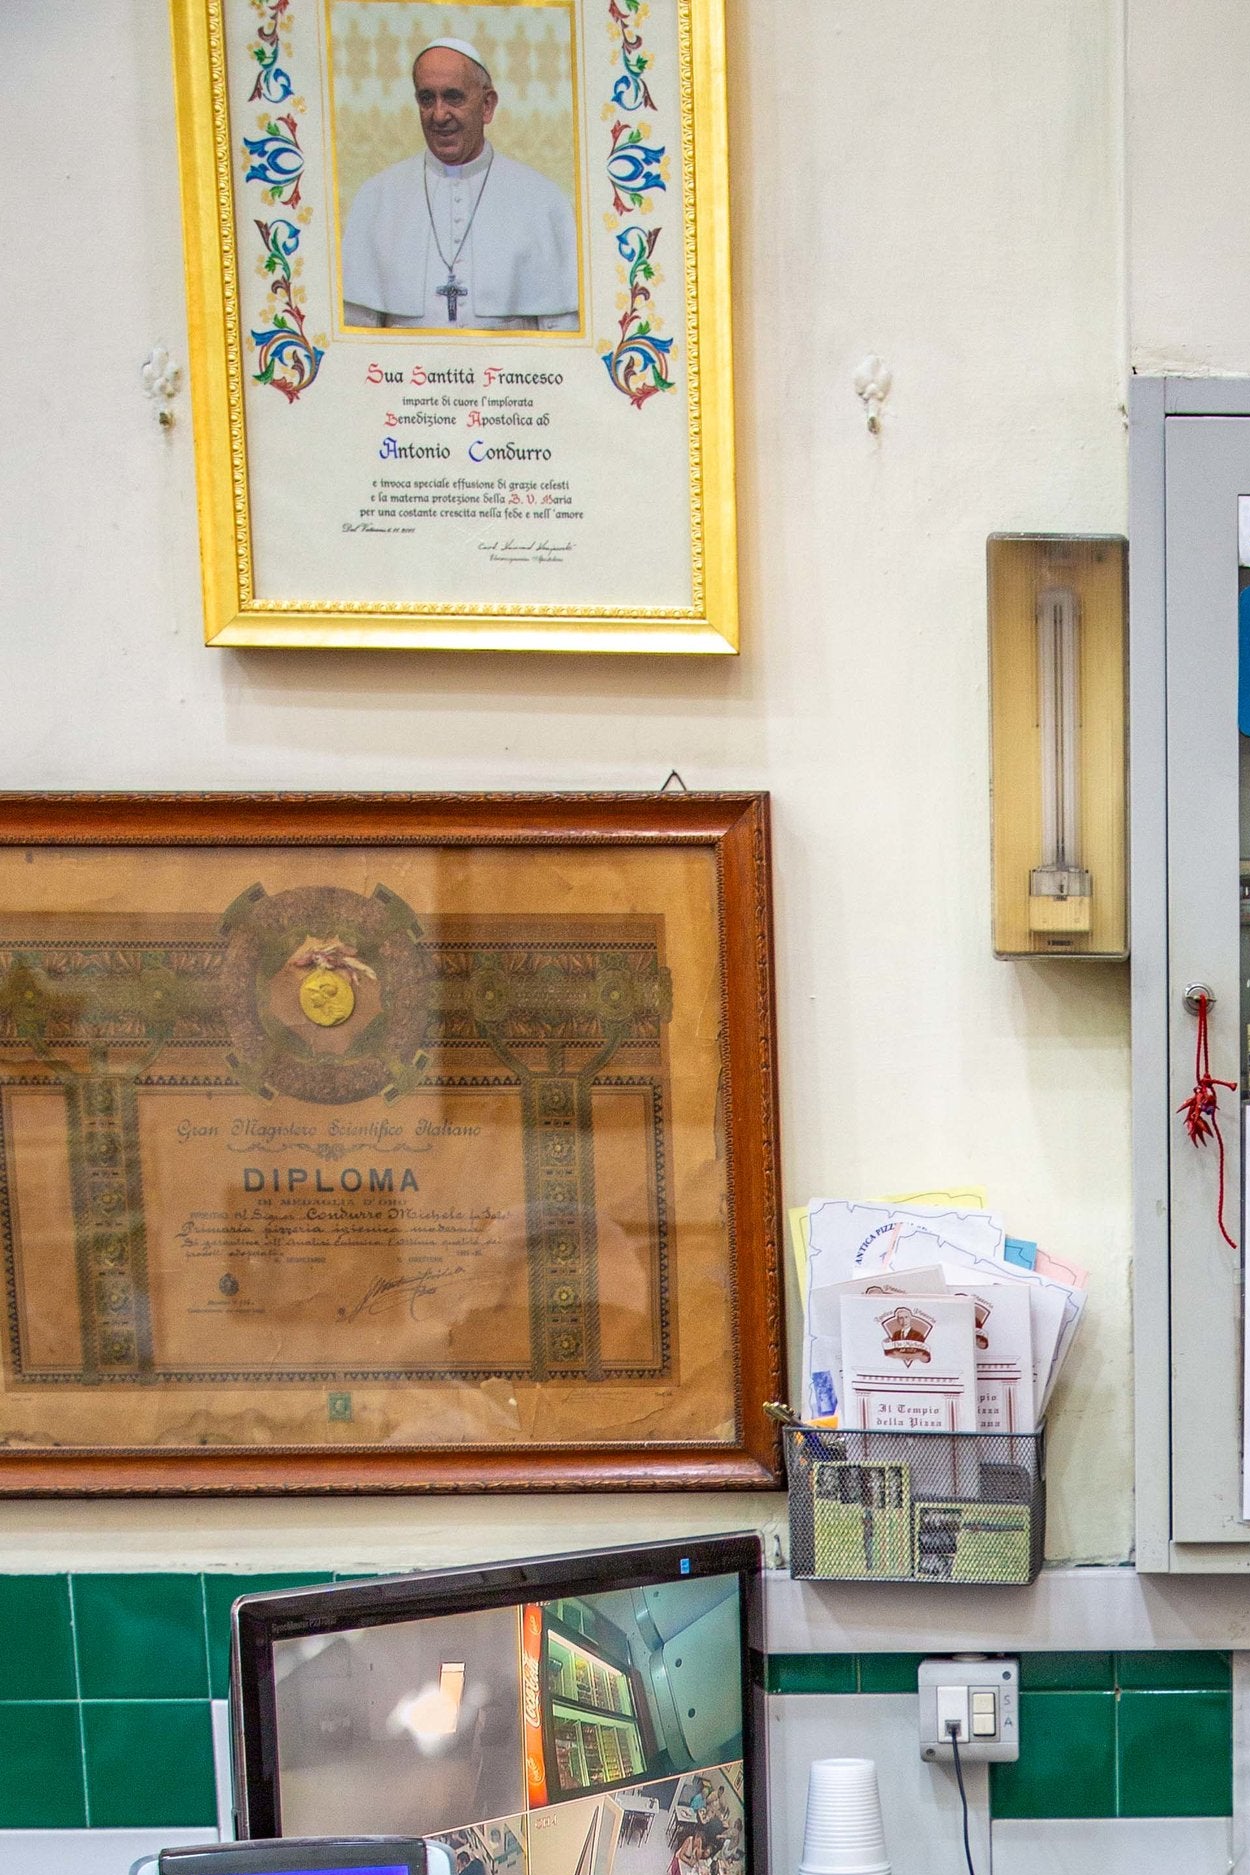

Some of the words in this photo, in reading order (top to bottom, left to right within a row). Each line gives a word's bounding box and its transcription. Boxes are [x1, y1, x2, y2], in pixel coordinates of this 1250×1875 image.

[365, 363, 404, 385] Sua
[410, 365, 475, 386] Santità
[483, 367, 563, 387] Francesco
[402, 397, 440, 407] imparte
[441, 395, 451, 406] di
[453, 398, 479, 407] cuore
[384, 411, 457, 428] Benedizione
[466, 410, 533, 427] Apostolica
[536, 413, 550, 426] ad
[379, 437, 451, 460] Antonio
[468, 440, 551, 462] Condurro
[243, 1168, 420, 1193] DIPLOMA
[879, 1404, 892, 1414] Il
[897, 1404, 940, 1416] Tempio
[876, 1417, 904, 1426] della
[910, 1417, 942, 1428] Pizza
